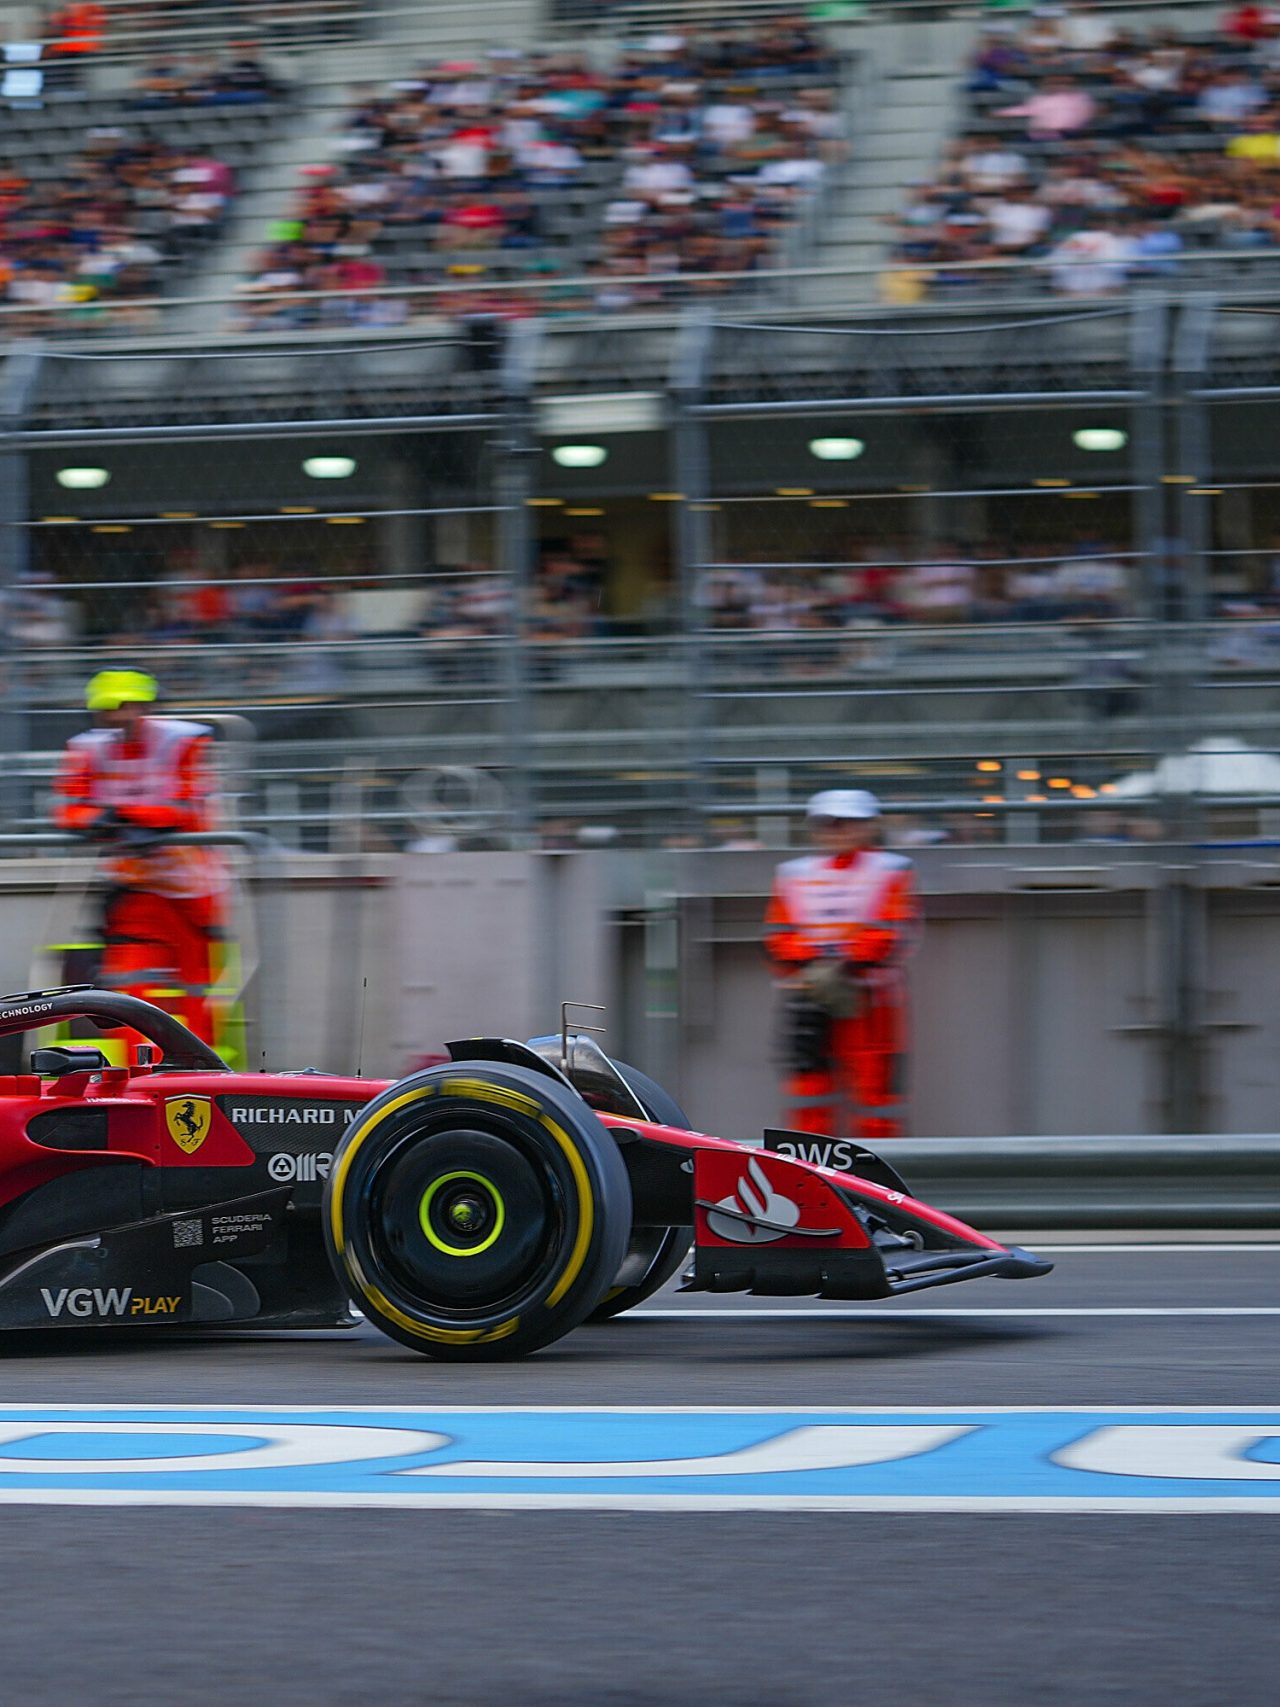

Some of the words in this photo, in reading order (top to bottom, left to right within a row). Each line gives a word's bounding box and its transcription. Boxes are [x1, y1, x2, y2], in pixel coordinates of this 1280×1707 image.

[232, 1108, 335, 1124] RICHARD
[776, 1142, 853, 1171] aws
[211, 1213, 272, 1225] SCUDERIA
[212, 1223, 263, 1234] FERRARI
[212, 1234, 238, 1244] APP
[40, 1287, 132, 1317] VGW
[131, 1296, 181, 1315] PLAY
